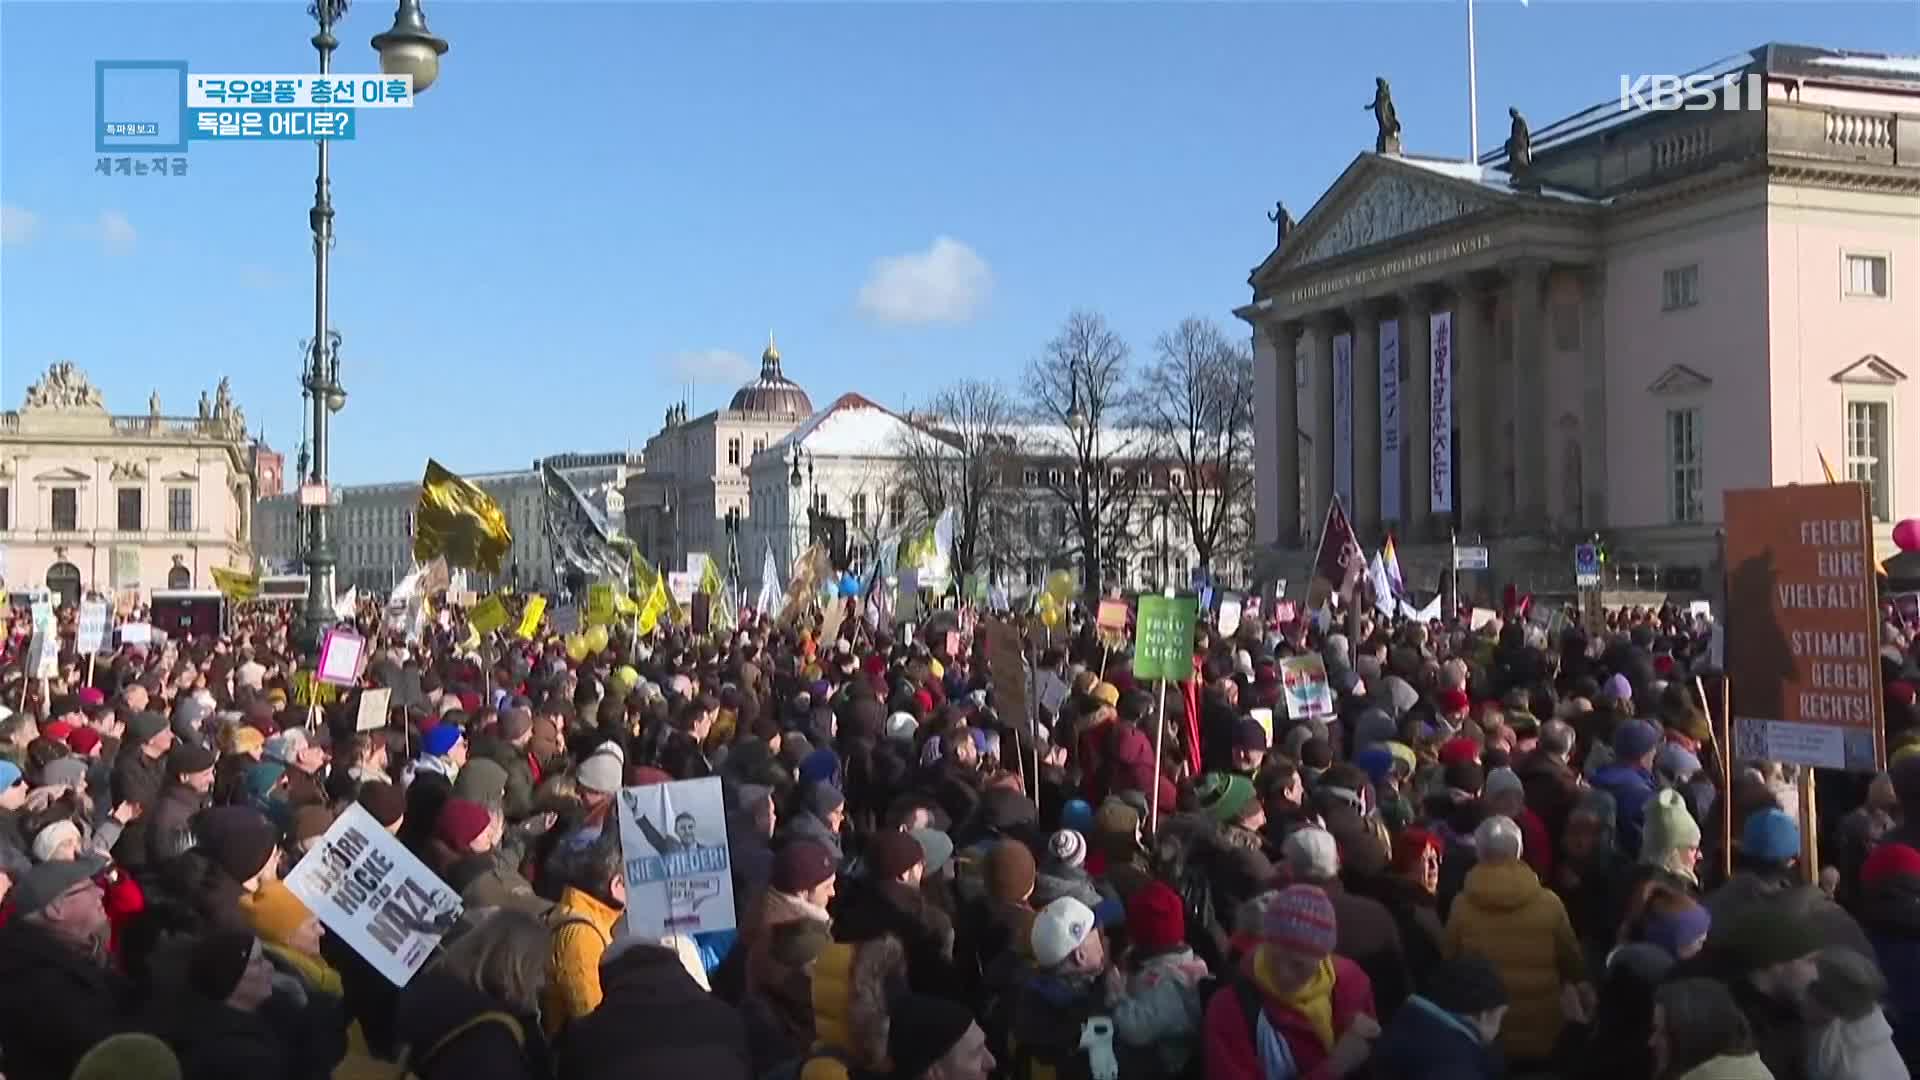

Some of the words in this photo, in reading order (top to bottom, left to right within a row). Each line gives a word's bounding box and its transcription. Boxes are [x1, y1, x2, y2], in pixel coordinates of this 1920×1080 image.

[1801, 519, 1863, 545] FEIERT
[1817, 551, 1864, 577] EURE
[1778, 583, 1865, 609] VIELFALT!
[1791, 631, 1868, 657] STIMMT
[1811, 662, 1870, 689] GEGEN
[1800, 695, 1872, 721] RECHTS!
[331, 847, 394, 917] HÖCKE
[365, 875, 437, 956] NAZI
